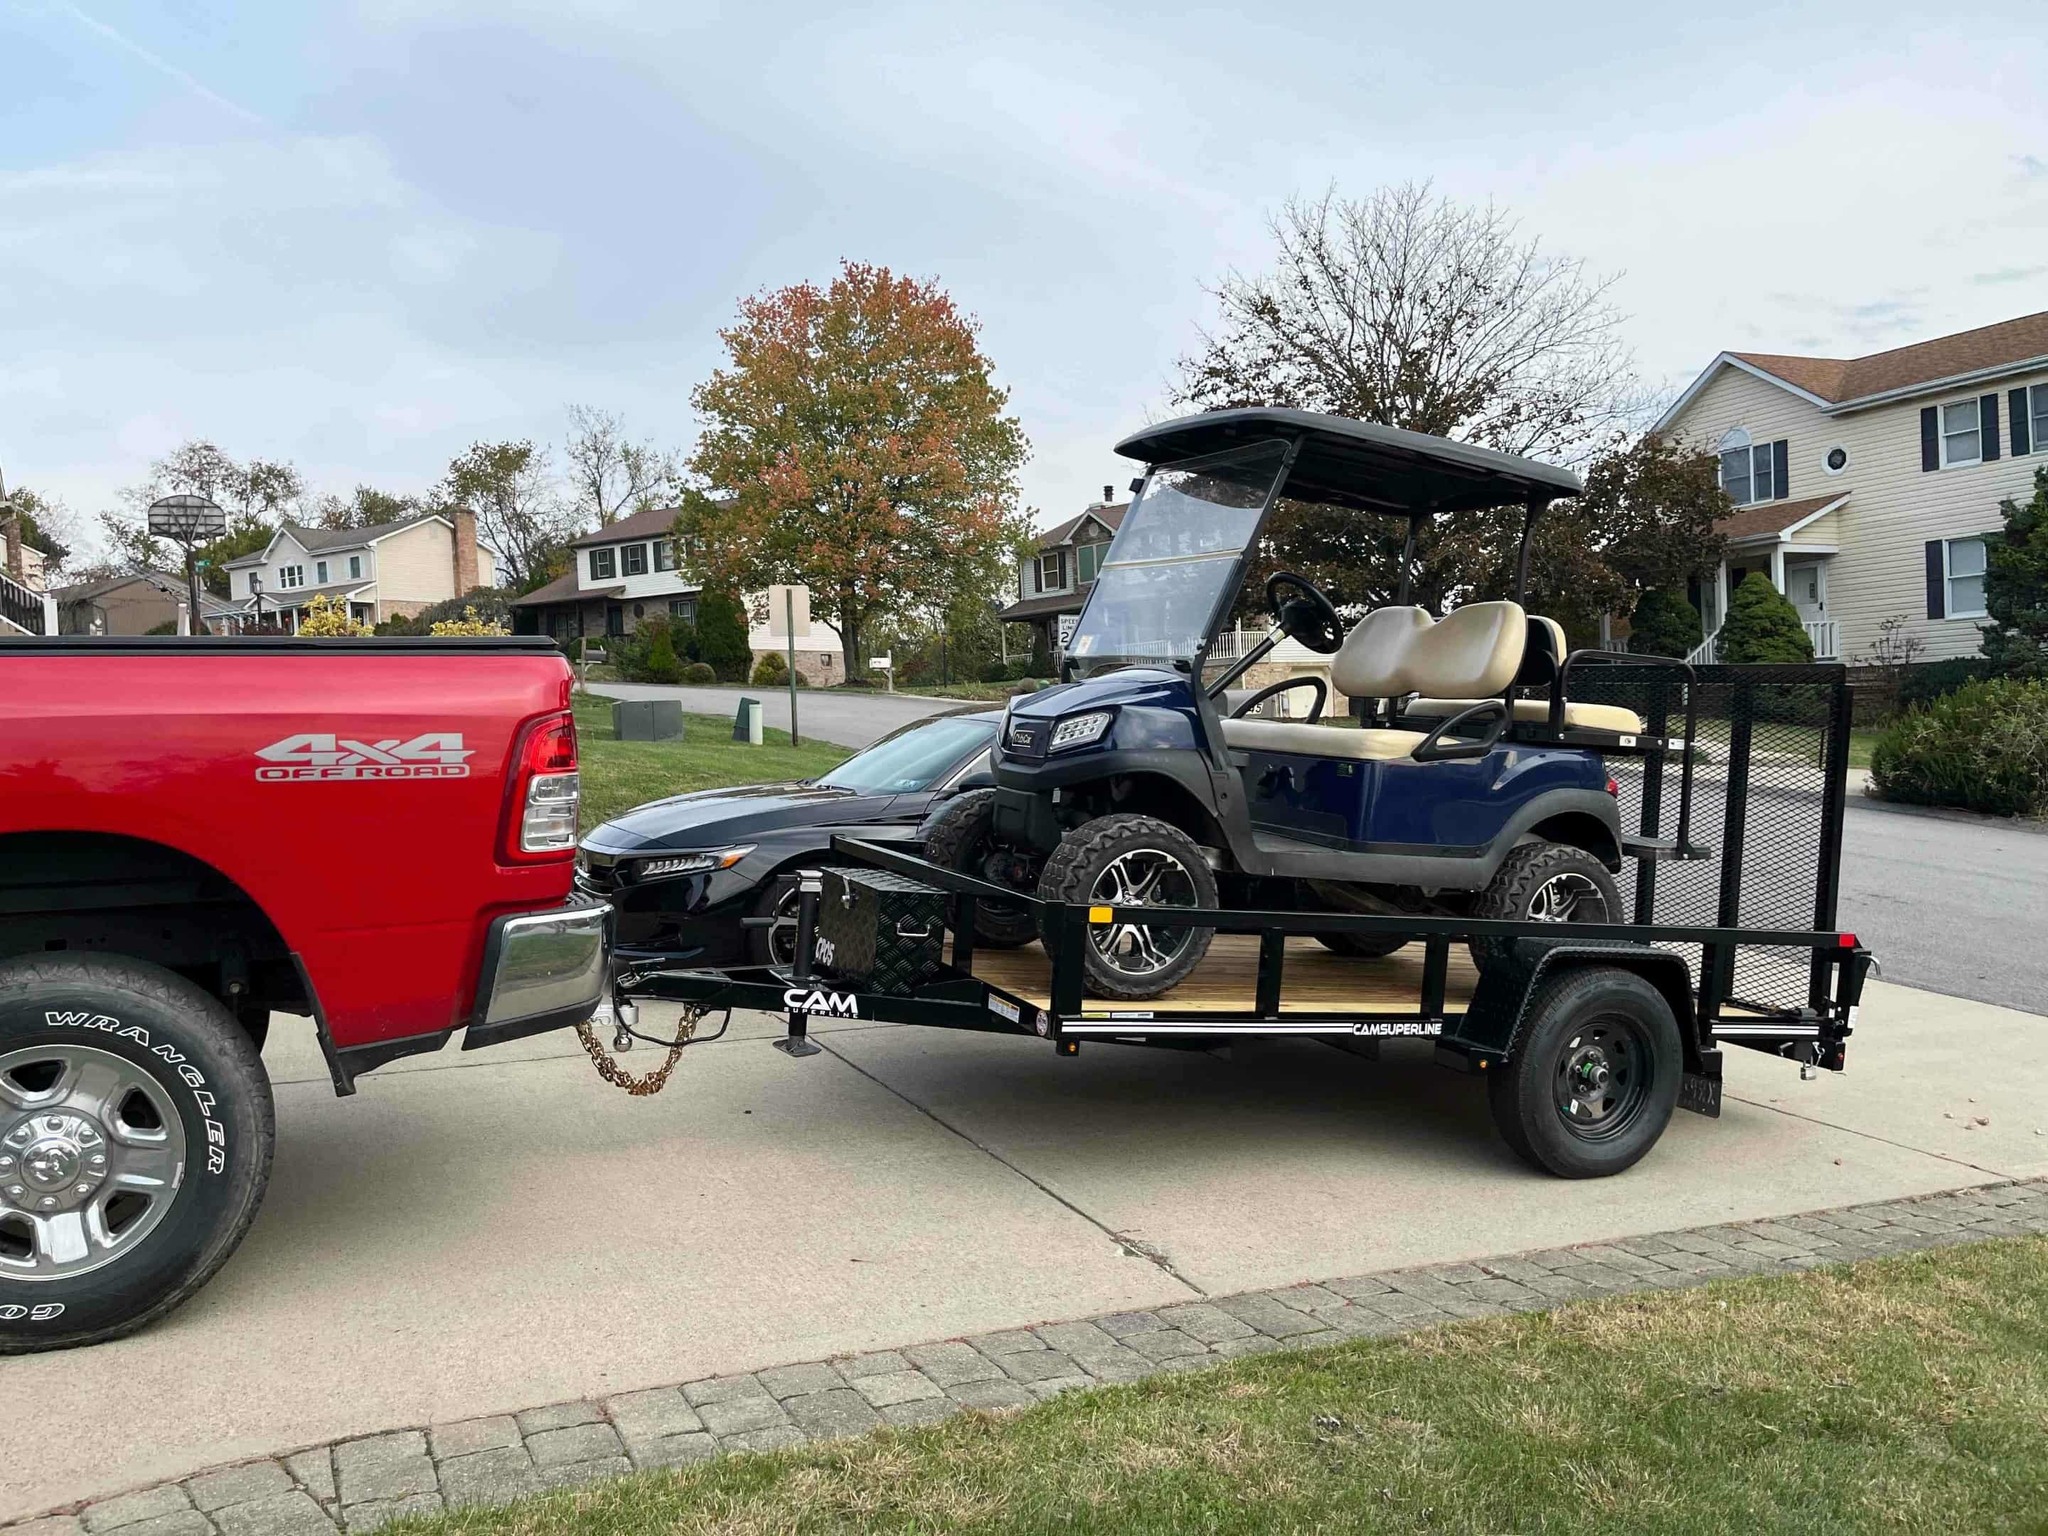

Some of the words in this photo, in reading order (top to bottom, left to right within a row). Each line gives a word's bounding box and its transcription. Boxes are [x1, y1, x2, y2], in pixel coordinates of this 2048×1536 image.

[1060, 631, 1070, 643] 2
[254, 733, 477, 766] 4x4
[260, 768, 346, 779] OFF
[355, 766, 463, 778] ROAD
[783, 988, 858, 1014] CAM
[783, 1006, 859, 1019] SUPERLINE
[45, 1011, 225, 1175] WRANGLER
